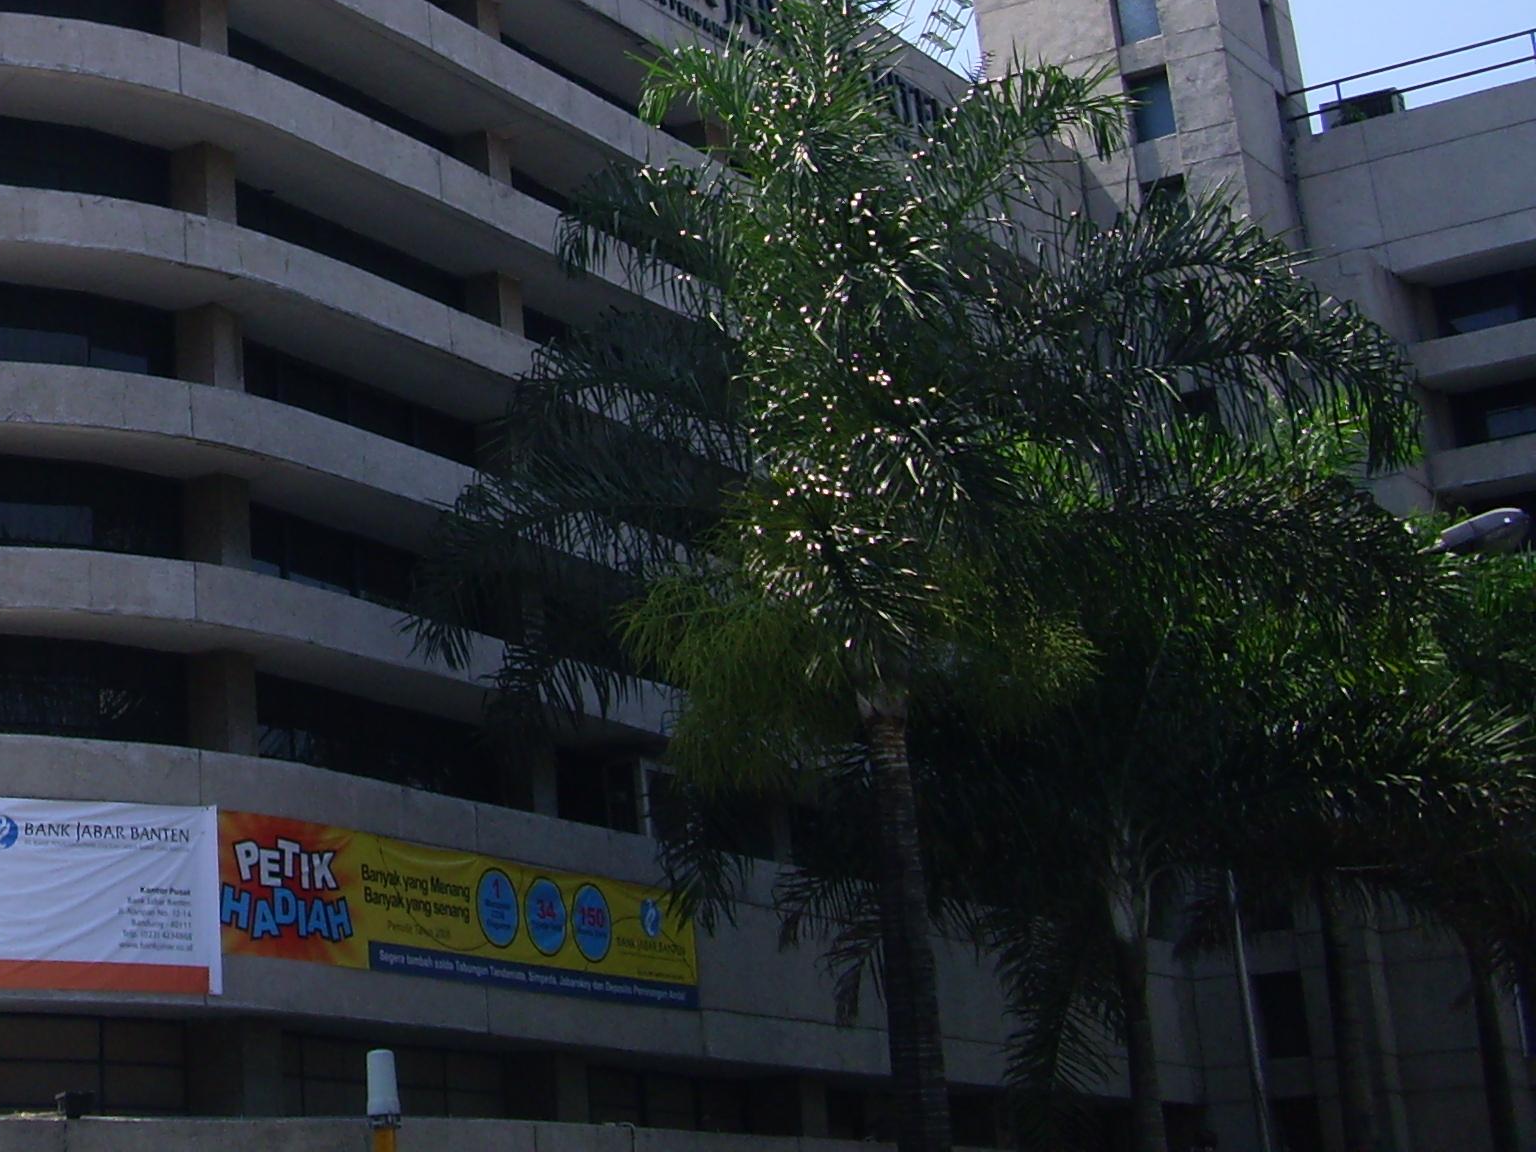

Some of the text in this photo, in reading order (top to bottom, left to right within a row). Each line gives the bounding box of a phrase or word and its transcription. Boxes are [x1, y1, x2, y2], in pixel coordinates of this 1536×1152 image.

[24, 821, 191, 844] BANK JABAR BANTEN
[233, 835, 339, 891] PETIK
[361, 863, 471, 903] Banyak yang Menang
[220, 882, 354, 943] HADIAH
[364, 886, 406, 911] Banyak
[406, 897, 432, 918] yang
[433, 901, 471, 924] senang
[536, 899, 556, 920] 34
[577, 906, 606, 928] 150
